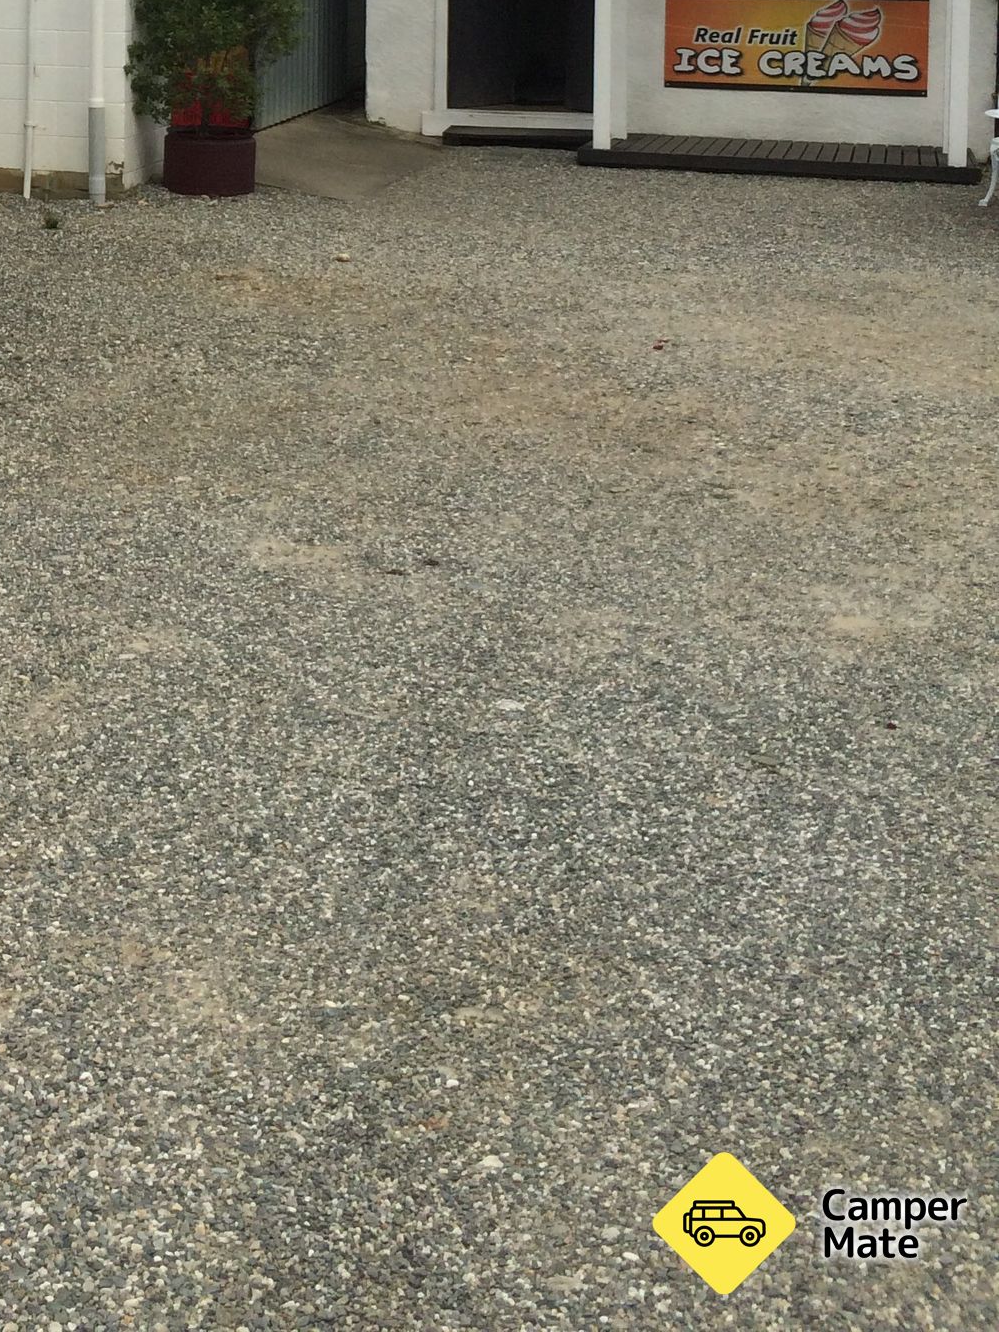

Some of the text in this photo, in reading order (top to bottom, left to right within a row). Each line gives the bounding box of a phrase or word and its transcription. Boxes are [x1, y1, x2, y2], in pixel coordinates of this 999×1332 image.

[694, 27, 798, 46] Real Fruit
[673, 48, 920, 81] ICE CREAMS
